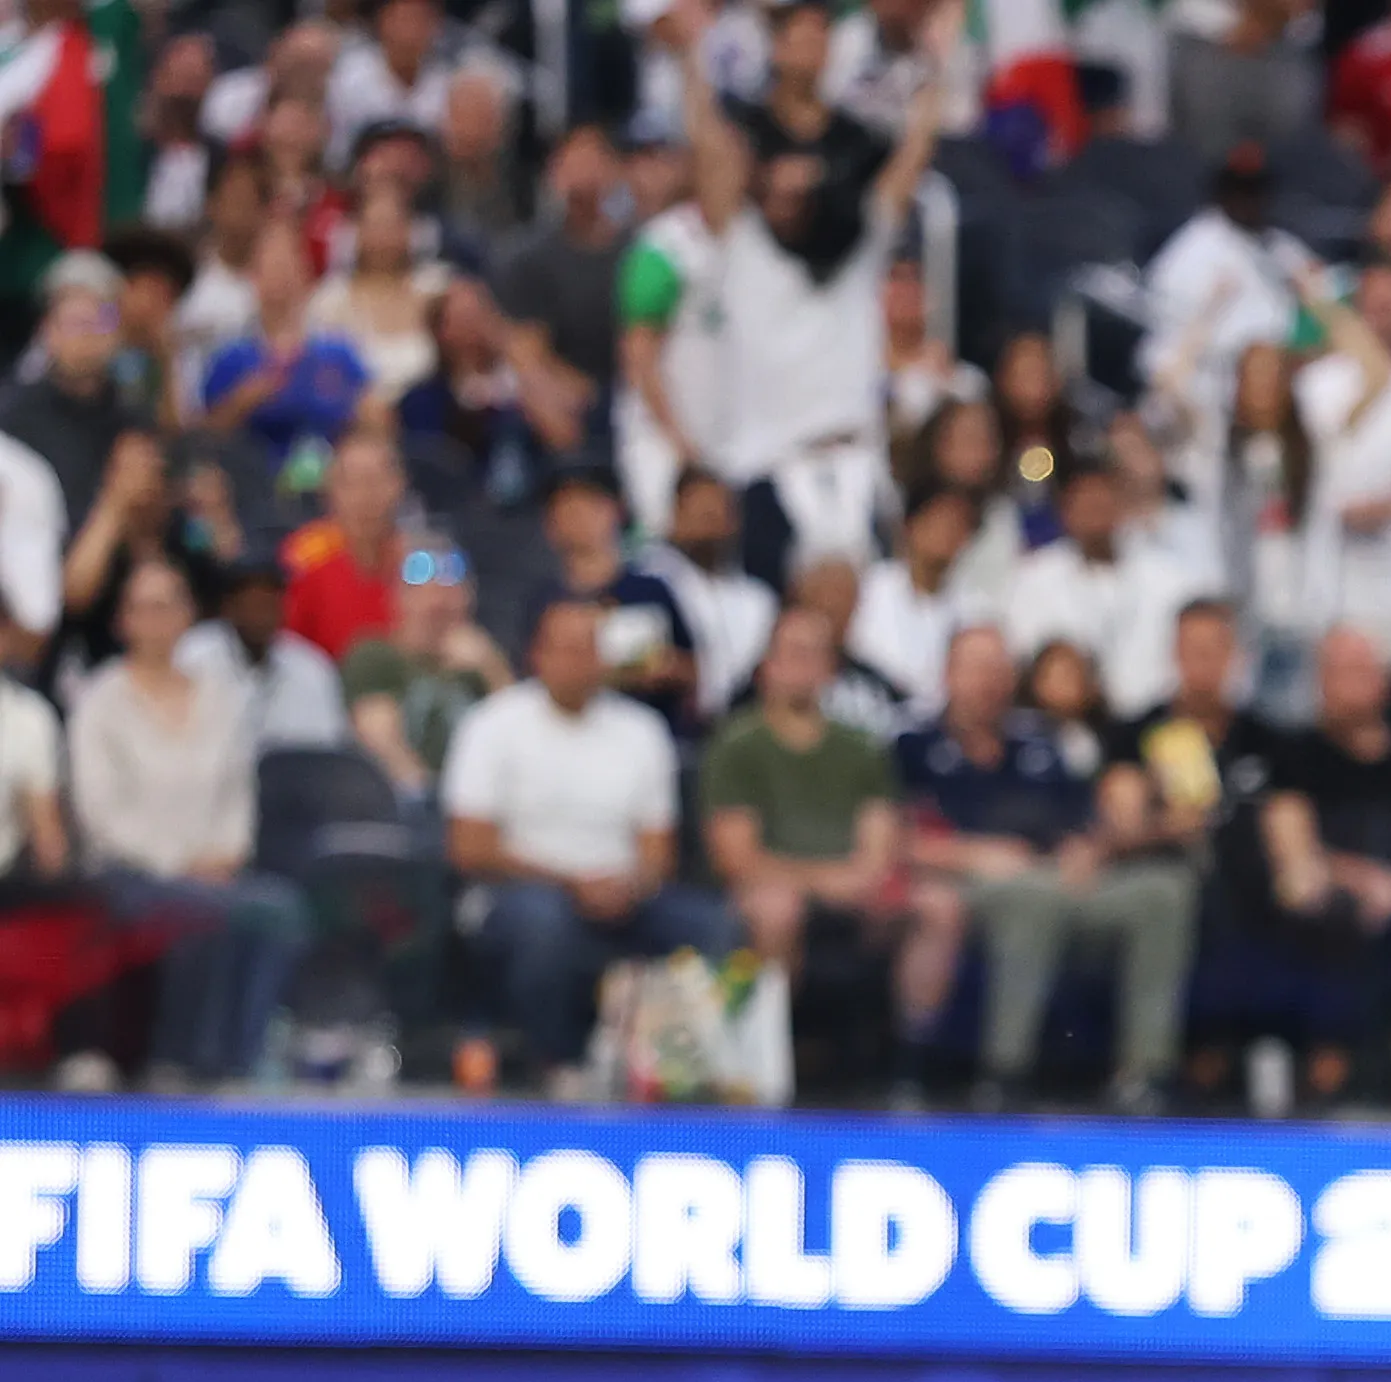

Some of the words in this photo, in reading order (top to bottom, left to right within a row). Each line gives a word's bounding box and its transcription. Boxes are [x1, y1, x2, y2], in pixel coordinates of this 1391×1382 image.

[0, 1140, 342, 1298] FIFA
[353, 1146, 959, 1311] WORLD
[969, 1161, 1306, 1318] CUP
